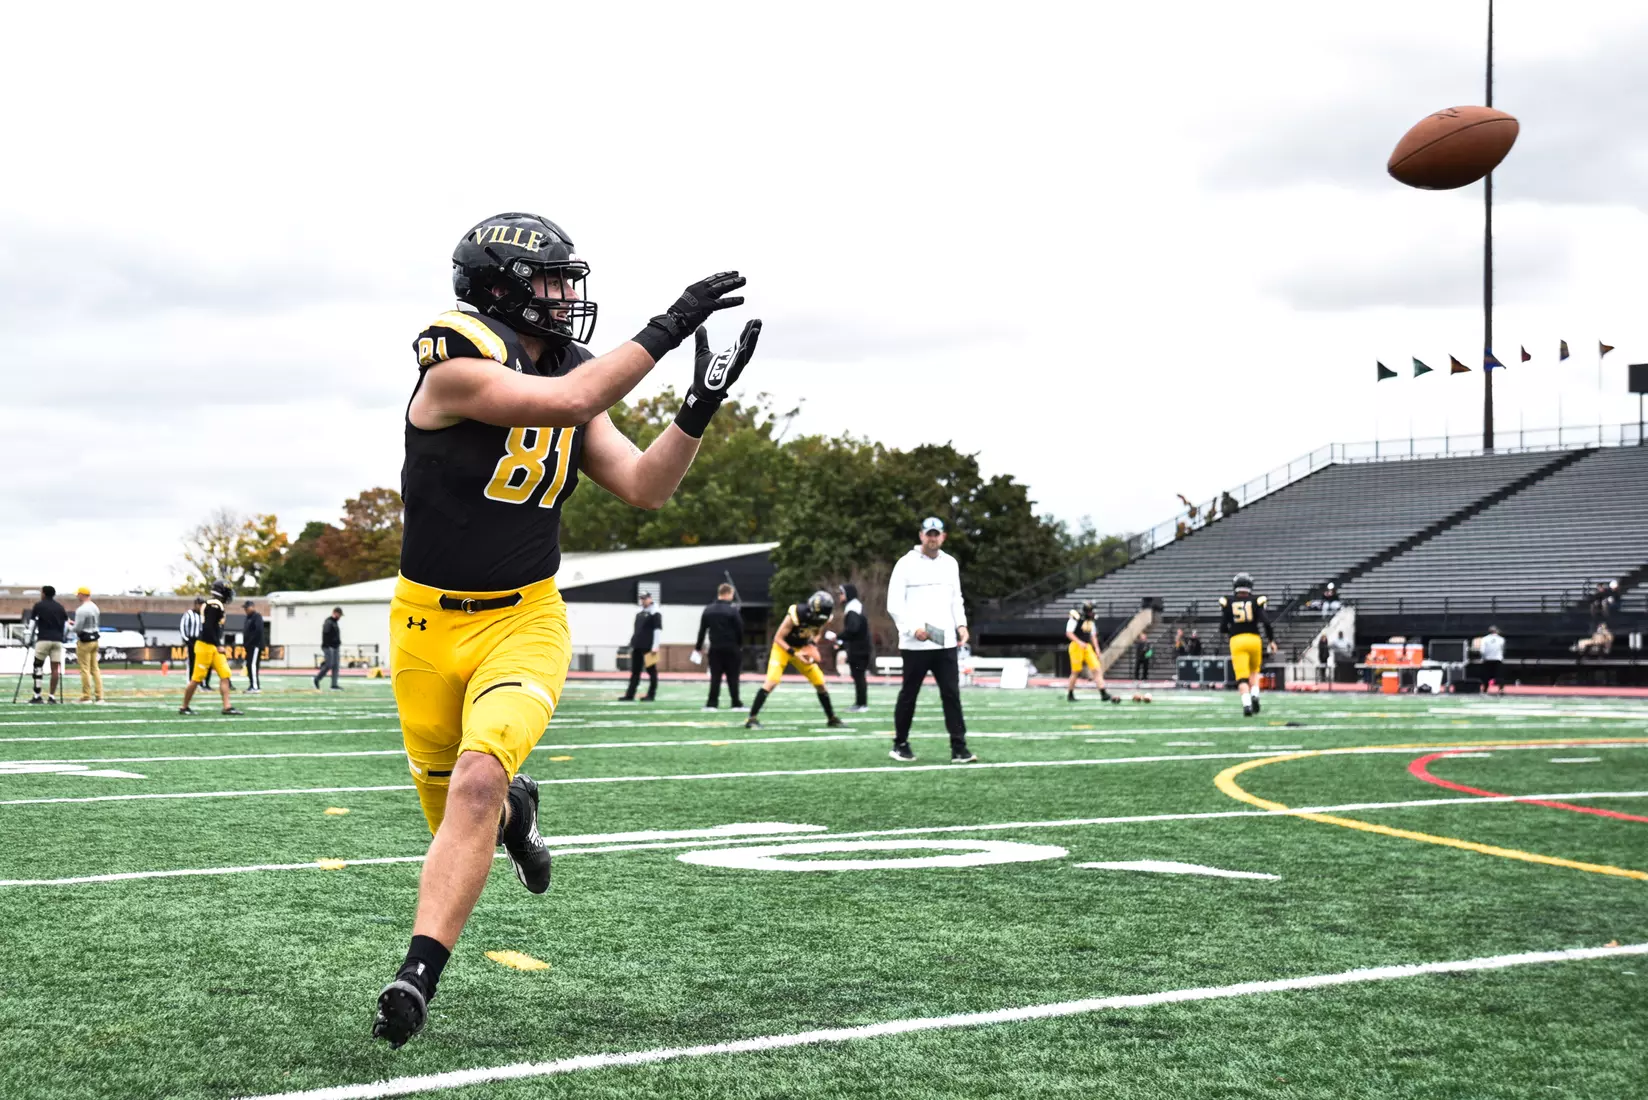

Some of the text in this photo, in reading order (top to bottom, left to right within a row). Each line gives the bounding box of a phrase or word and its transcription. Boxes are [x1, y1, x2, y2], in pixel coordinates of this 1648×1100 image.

[474, 225, 544, 253] VILLE
[484, 427, 576, 509] 81
[1231, 600, 1254, 623] 51
